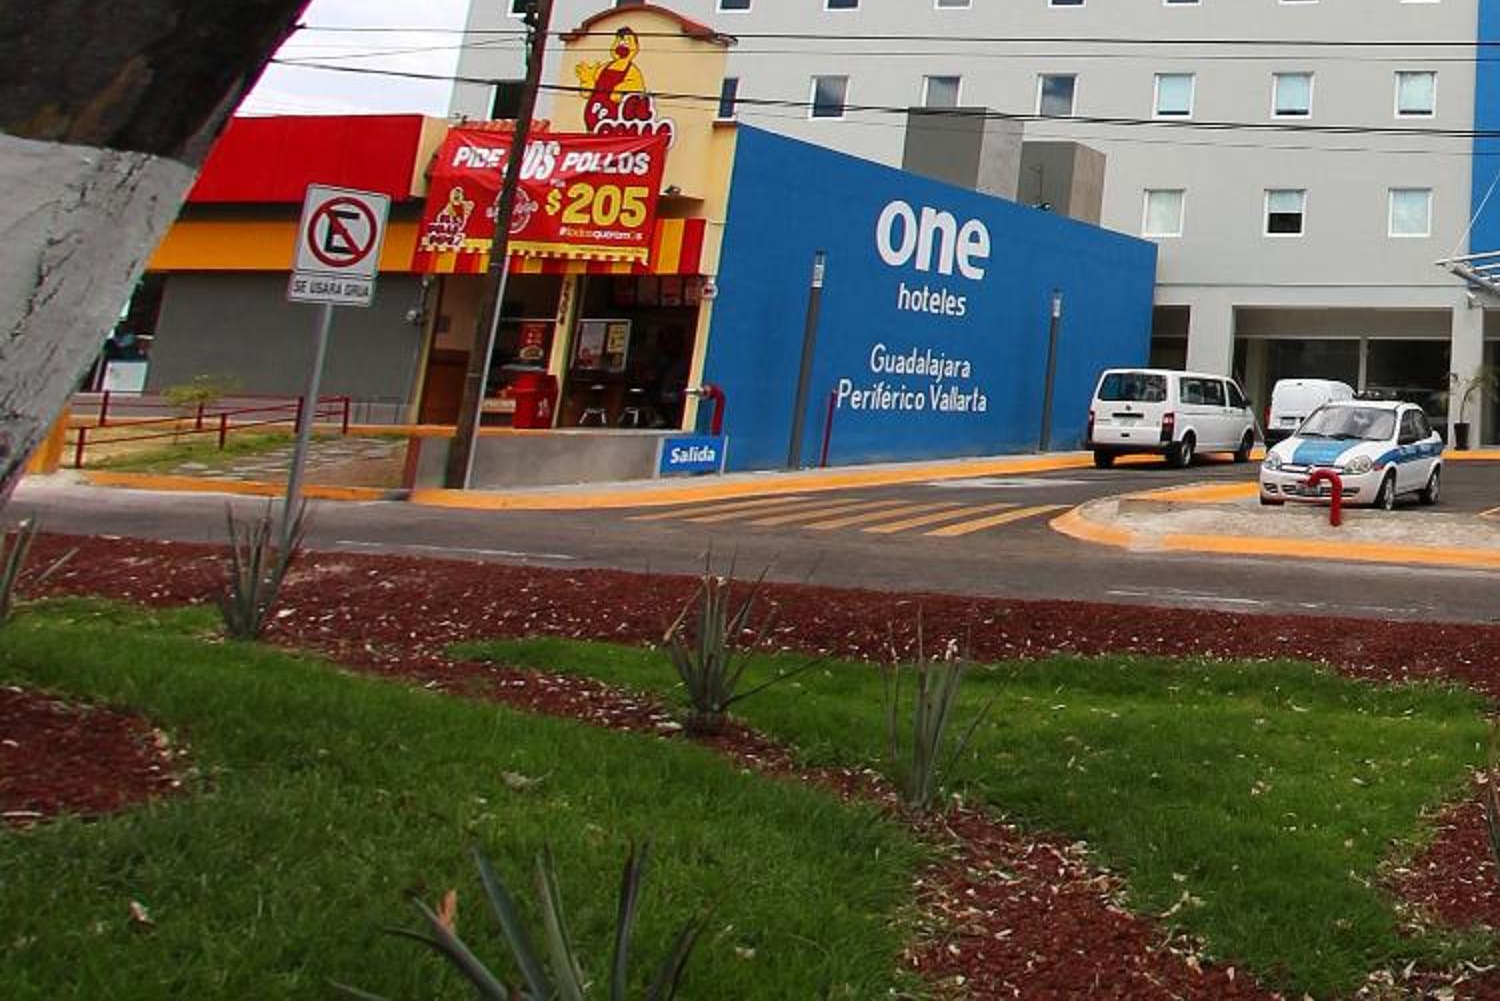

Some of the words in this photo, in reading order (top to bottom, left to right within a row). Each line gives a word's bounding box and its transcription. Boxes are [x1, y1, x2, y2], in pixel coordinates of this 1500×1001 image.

[452, 146, 505, 168] PIDE
[502, 140, 560, 179] OS
[560, 151, 651, 175] POLLOS
[875, 199, 991, 280] one
[293, 280, 308, 295] SE
[896, 282, 967, 317] hoteles
[869, 343, 972, 382] Guadalajara
[836, 377, 926, 412] Periférico
[929, 384, 988, 413] Vallarta
[669, 447, 716, 464] Salida
